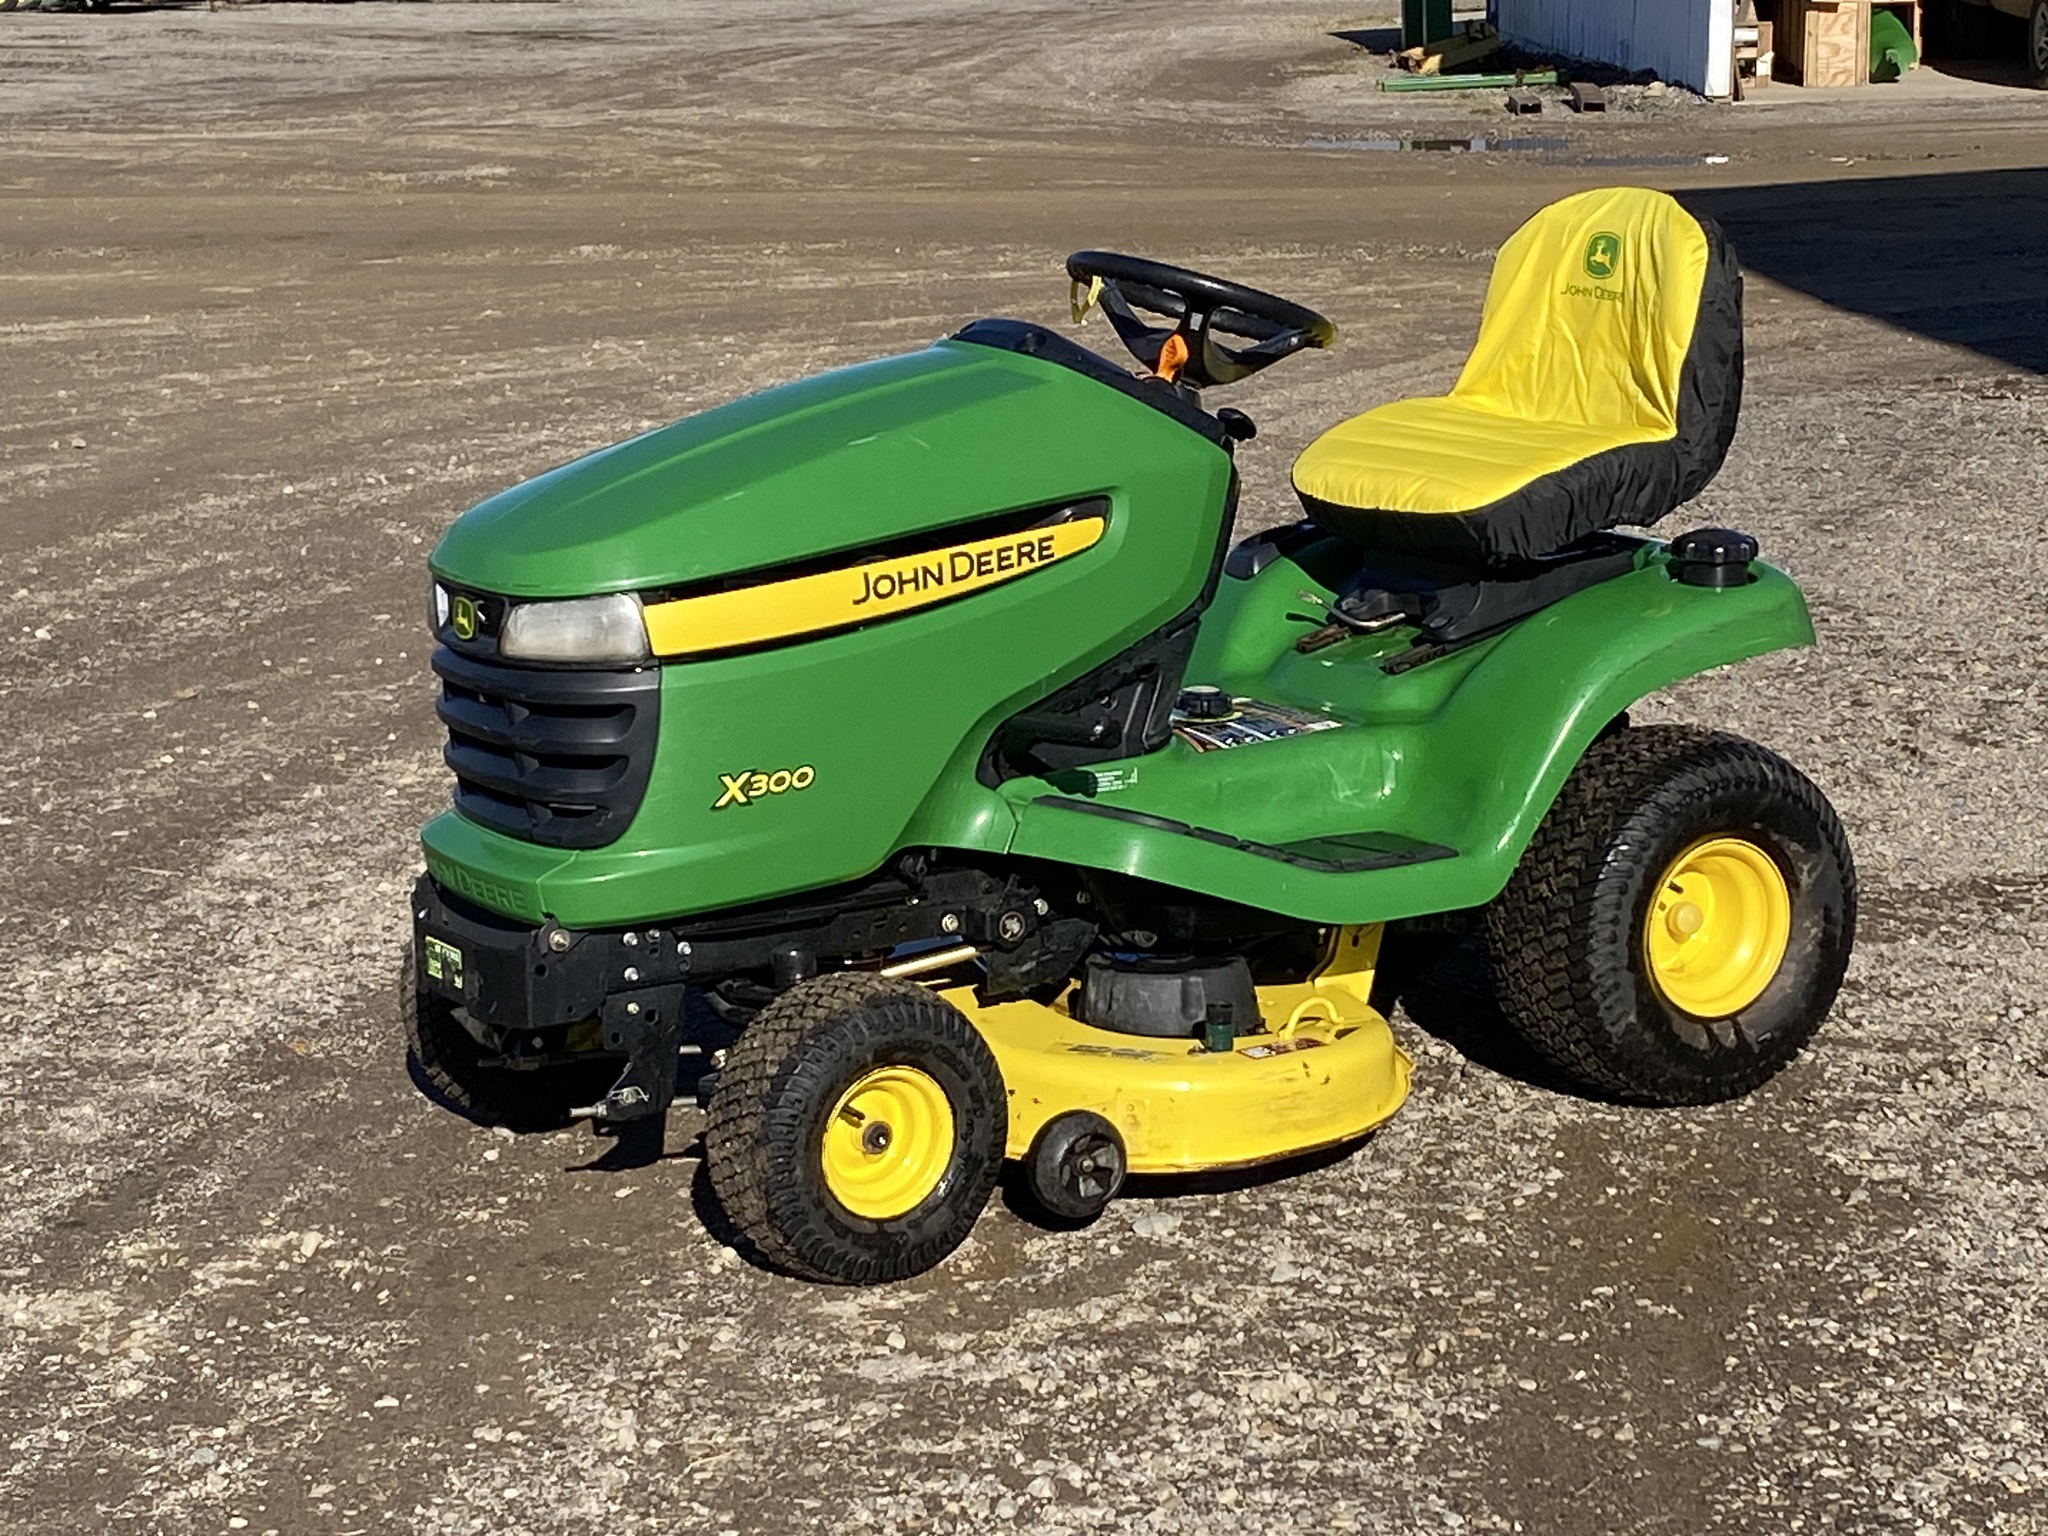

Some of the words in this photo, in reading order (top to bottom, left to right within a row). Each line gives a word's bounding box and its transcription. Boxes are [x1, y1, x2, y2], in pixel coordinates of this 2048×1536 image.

[1560, 282, 1593, 298] JOHN
[852, 562, 944, 606] JOHN
[949, 534, 1055, 583] DEERE
[709, 765, 816, 811] X300
[456, 865, 527, 914] DEERE
